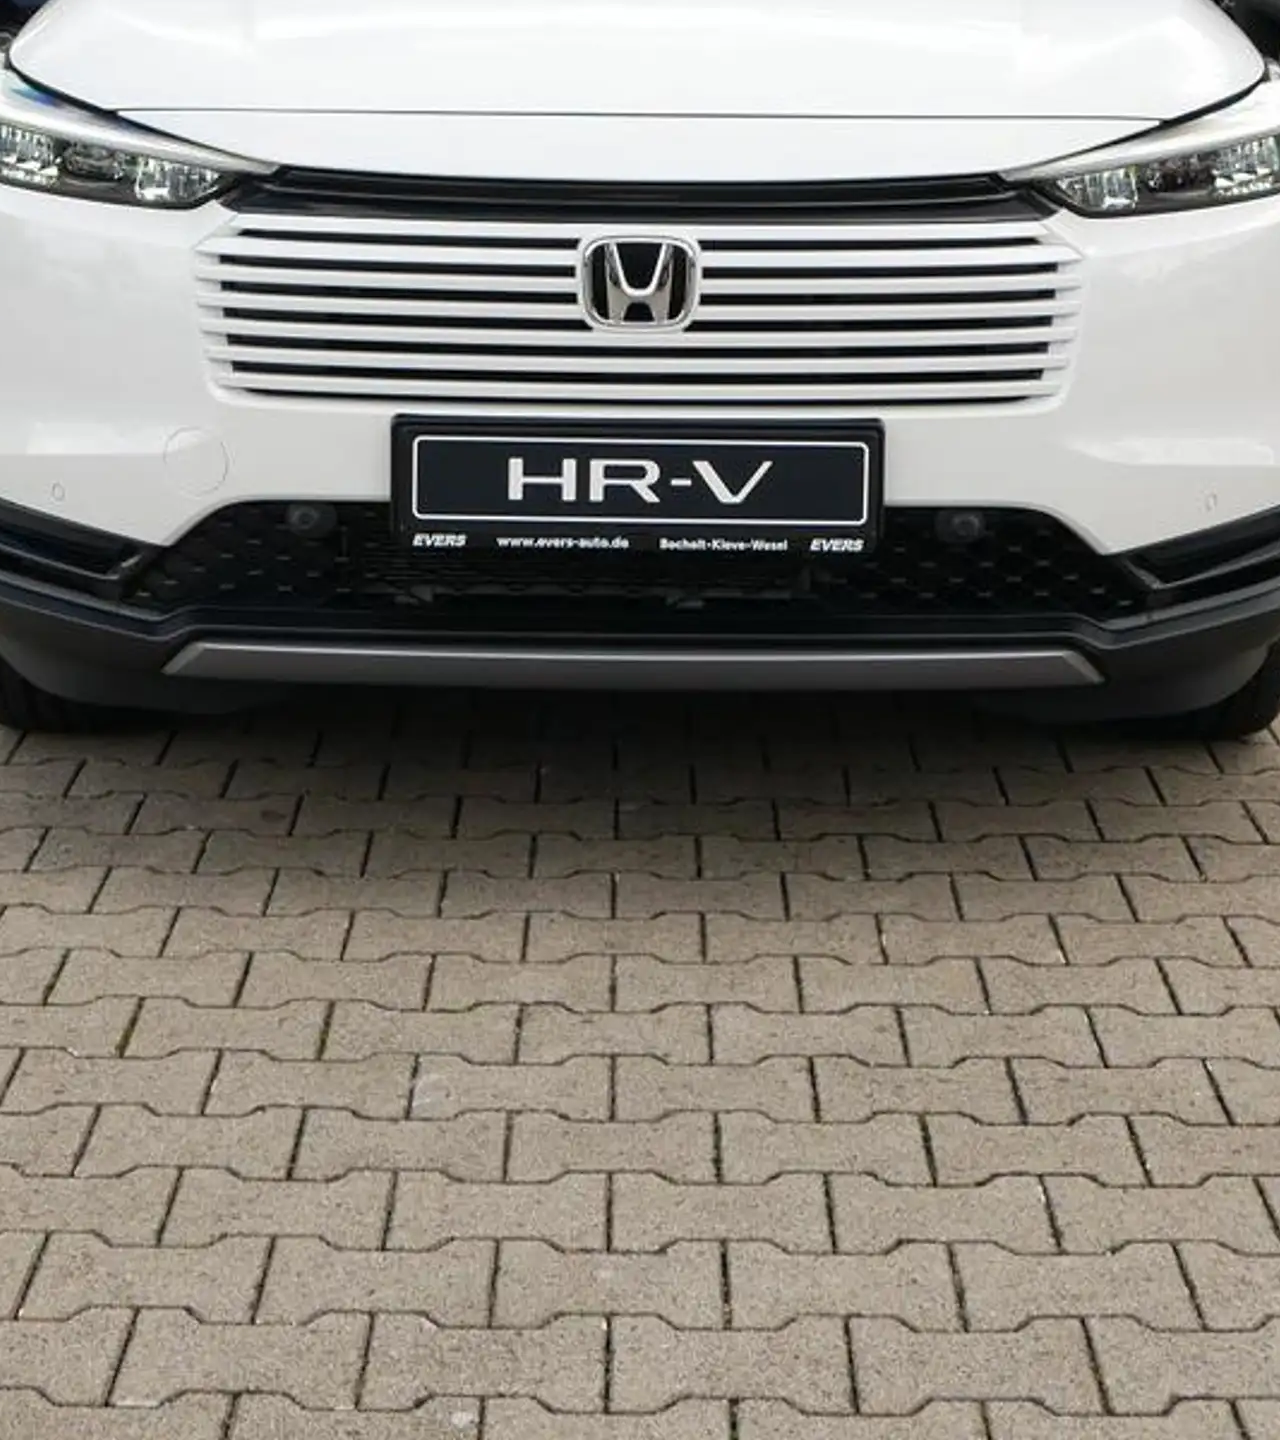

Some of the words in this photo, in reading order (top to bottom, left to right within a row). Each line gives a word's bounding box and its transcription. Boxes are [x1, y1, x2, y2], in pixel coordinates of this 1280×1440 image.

[508, 457, 773, 504] HR-V
[412, 533, 467, 548] EVERS
[496, 536, 630, 549] www.evers-auto.de
[809, 538, 865, 552] EVERS
